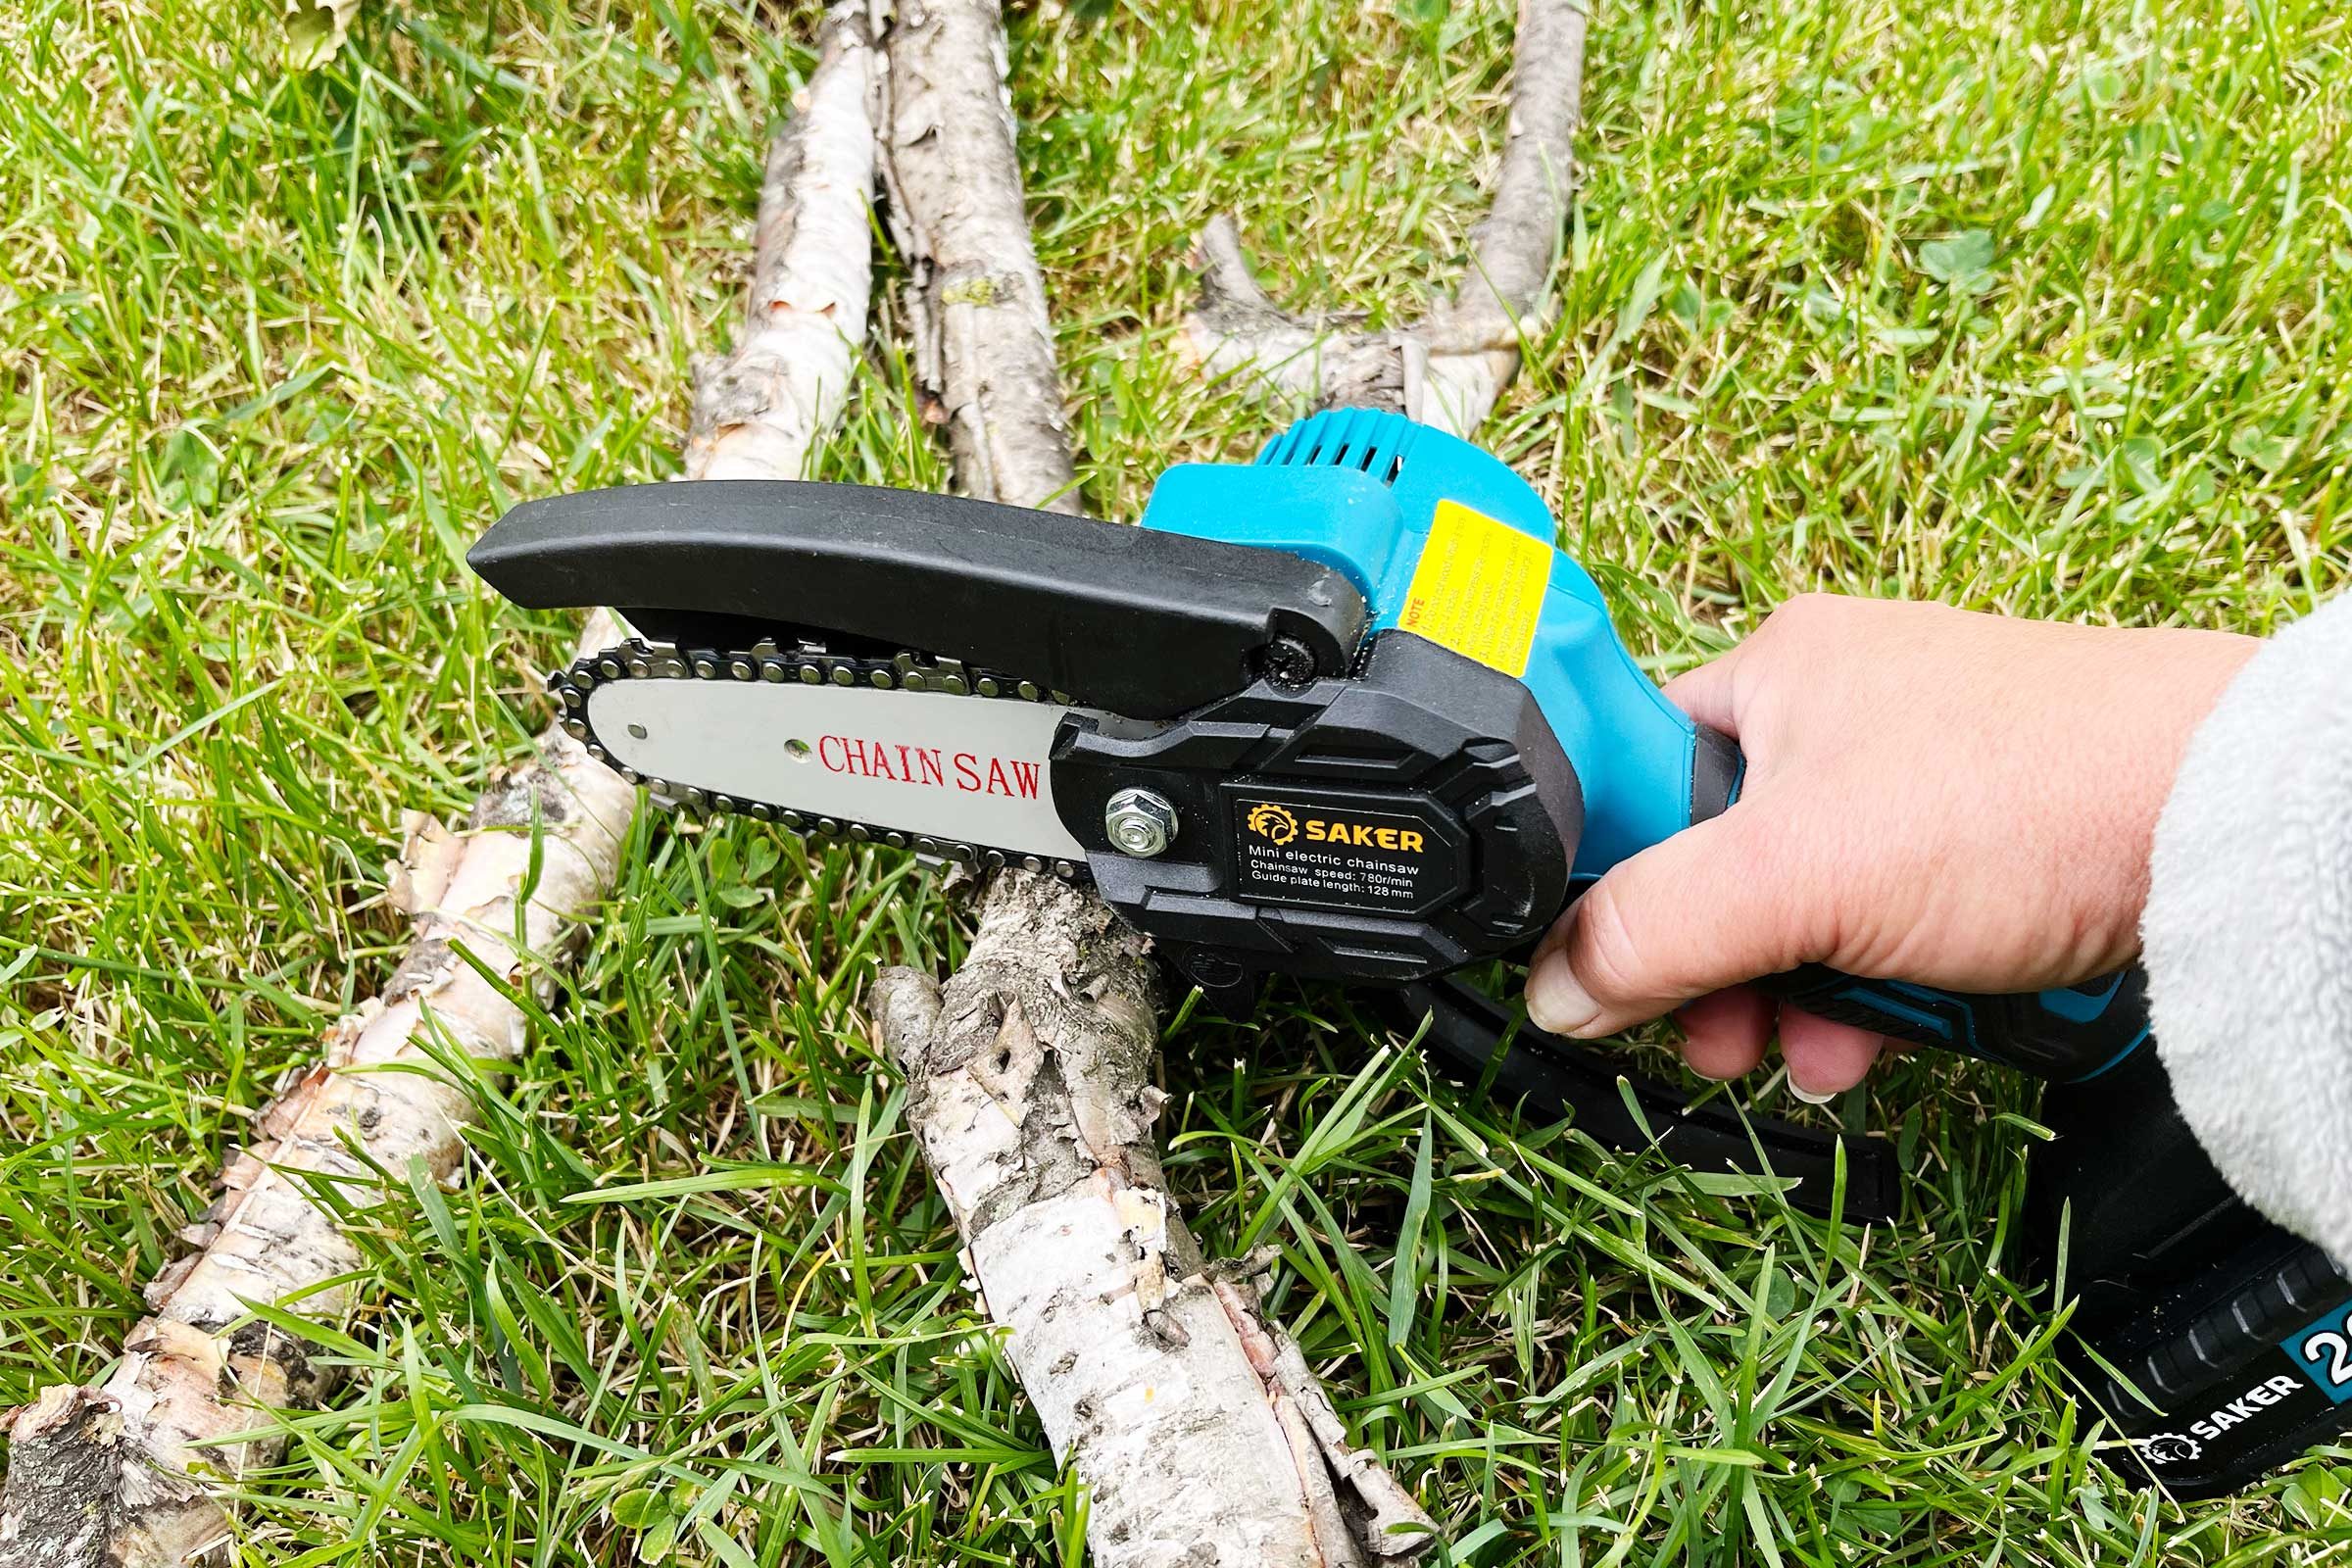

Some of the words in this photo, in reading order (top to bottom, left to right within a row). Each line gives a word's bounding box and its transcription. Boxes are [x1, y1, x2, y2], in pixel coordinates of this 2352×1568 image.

[1406, 598, 1425, 627] NOTE
[818, 735, 945, 787] CHAIN
[954, 754, 1041, 800] SAW
[1305, 820, 1424, 854] SAKER
[1249, 845, 1280, 858] Mini
[1285, 850, 1341, 865] electric
[1347, 858, 1419, 875] chainsaw
[1250, 859, 1308, 875] Chainsaw
[1314, 868, 1356, 881] speed:
[1360, 873, 1413, 888] 780r/min
[1251, 871, 1287, 883] Guide
[1290, 876, 1320, 888] plate
[1323, 880, 1365, 894] length:
[1367, 885, 1390, 897] 128
[1392, 889, 1414, 899] mm
[2190, 1375, 2304, 1440] SAKER
